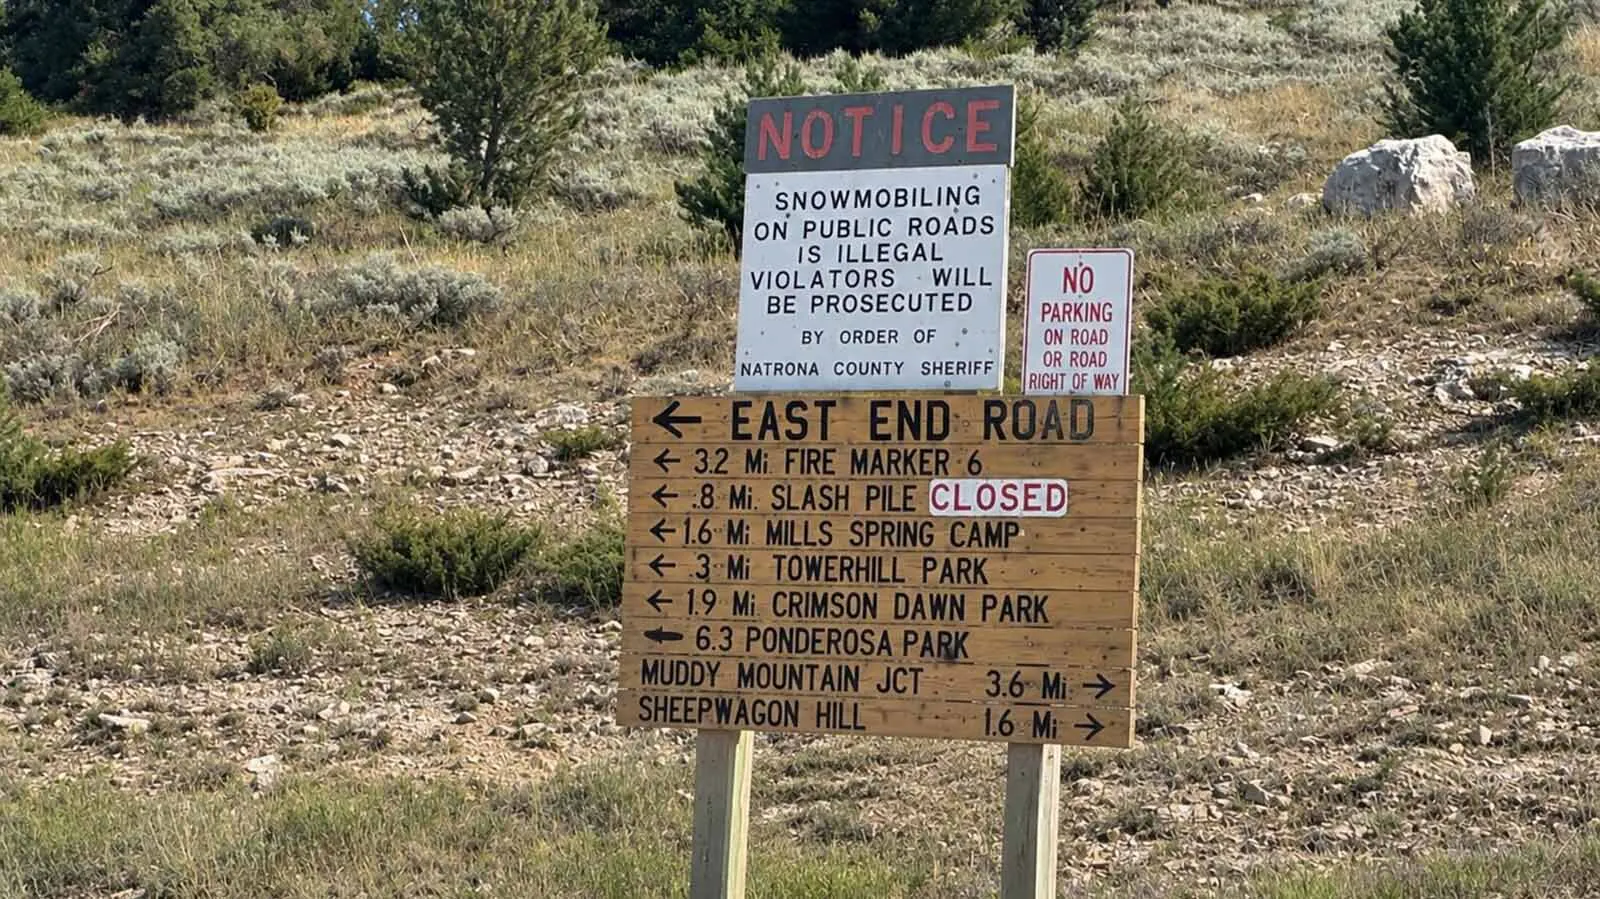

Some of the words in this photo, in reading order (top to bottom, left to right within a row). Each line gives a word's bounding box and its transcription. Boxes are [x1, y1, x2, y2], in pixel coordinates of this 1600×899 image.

[757, 100, 1001, 161] NOTICE
[775, 185, 981, 211] SNOWMOBILING
[754, 222, 788, 241] ON
[803, 218, 893, 239] PUBLIC
[908, 216, 995, 237] ROADS
[798, 246, 821, 264] IS
[838, 243, 944, 263] ILLEGAL
[750, 268, 896, 291] VIOLATORS
[932, 266, 992, 286] WILL
[1062, 266, 1094, 294] NO
[767, 296, 796, 314] BE
[811, 293, 972, 313] PROSECUTED
[1041, 302, 1113, 323] PARKING
[801, 330, 824, 345] BY
[840, 329, 899, 344] ORDER
[913, 329, 936, 343] OF
[1043, 329, 1064, 345] ON
[1070, 329, 1108, 345] ROAD
[741, 362, 819, 377] NATRONA
[833, 361, 905, 376] COUNTY
[920, 360, 994, 376] SHERIFF
[1043, 350, 1063, 367] OR
[1070, 351, 1107, 368] ROAD
[1029, 372, 1066, 389] RIGHT
[1072, 373, 1089, 389] OF
[1093, 373, 1120, 390] WAY
[731, 400, 837, 441] EAST
[869, 400, 950, 441] END
[983, 399, 1095, 442] ROAD
[694, 447, 729, 475] 3.2
[785, 448, 834, 475] FIRE
[850, 448, 950, 477] MARKER
[967, 450, 983, 477] 6
[772, 484, 849, 511] SLASH
[865, 485, 916, 512] PILE
[931, 483, 1067, 512] CLOSED
[683, 517, 713, 545] 1.6
[766, 520, 833, 547] MILLS
[849, 520, 935, 548] SPRING
[950, 522, 1021, 549] CAMP
[773, 555, 905, 583] TOWERHILL
[922, 557, 989, 585] PARK
[687, 588, 716, 616] 1.9
[772, 591, 878, 620] CRIMSON
[893, 593, 965, 622] DAWN
[981, 594, 1050, 624] PARK
[695, 625, 733, 652] 6.3
[745, 626, 892, 657] PONDEROSA
[902, 630, 970, 660] PARK
[641, 659, 721, 688] MUDDY
[737, 662, 860, 692] MOUNTAIN
[876, 667, 924, 696] JCT
[985, 669, 1024, 699] 3.6
[638, 696, 799, 728] SHEEPWAGON
[816, 702, 866, 731] HILL
[985, 708, 1014, 737] 1.6
